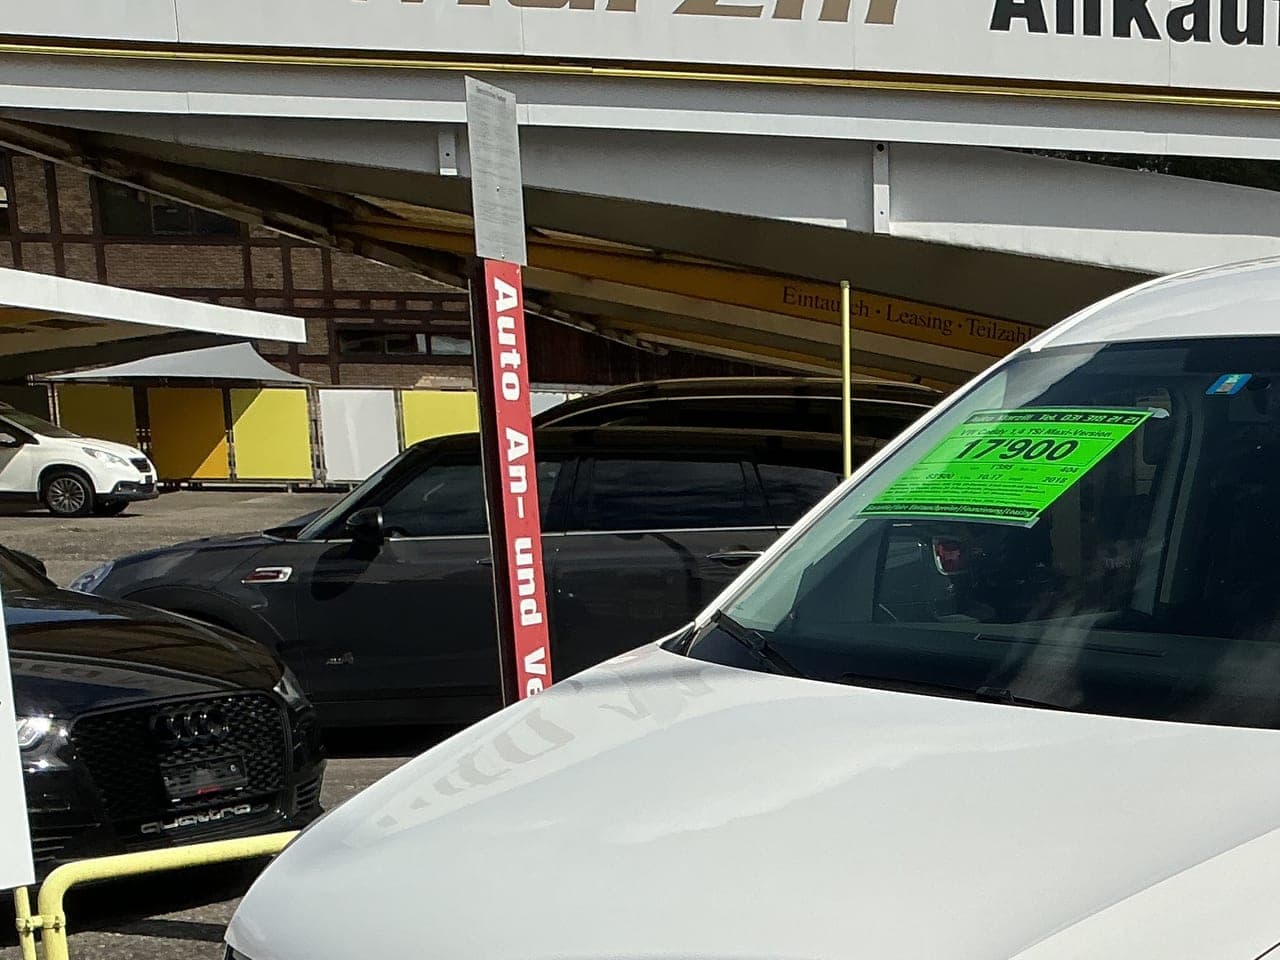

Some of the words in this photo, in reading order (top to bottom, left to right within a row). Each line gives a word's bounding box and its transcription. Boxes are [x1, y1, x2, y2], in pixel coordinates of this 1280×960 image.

[494, 277, 521, 401] Auto
[782, 285, 869, 318] Eintauch
[886, 304, 953, 336] Leasing
[505, 427, 529, 519] An-
[954, 438, 1079, 462] 17'900
[514, 537, 543, 626] und
[140, 803, 251, 835] quattro
